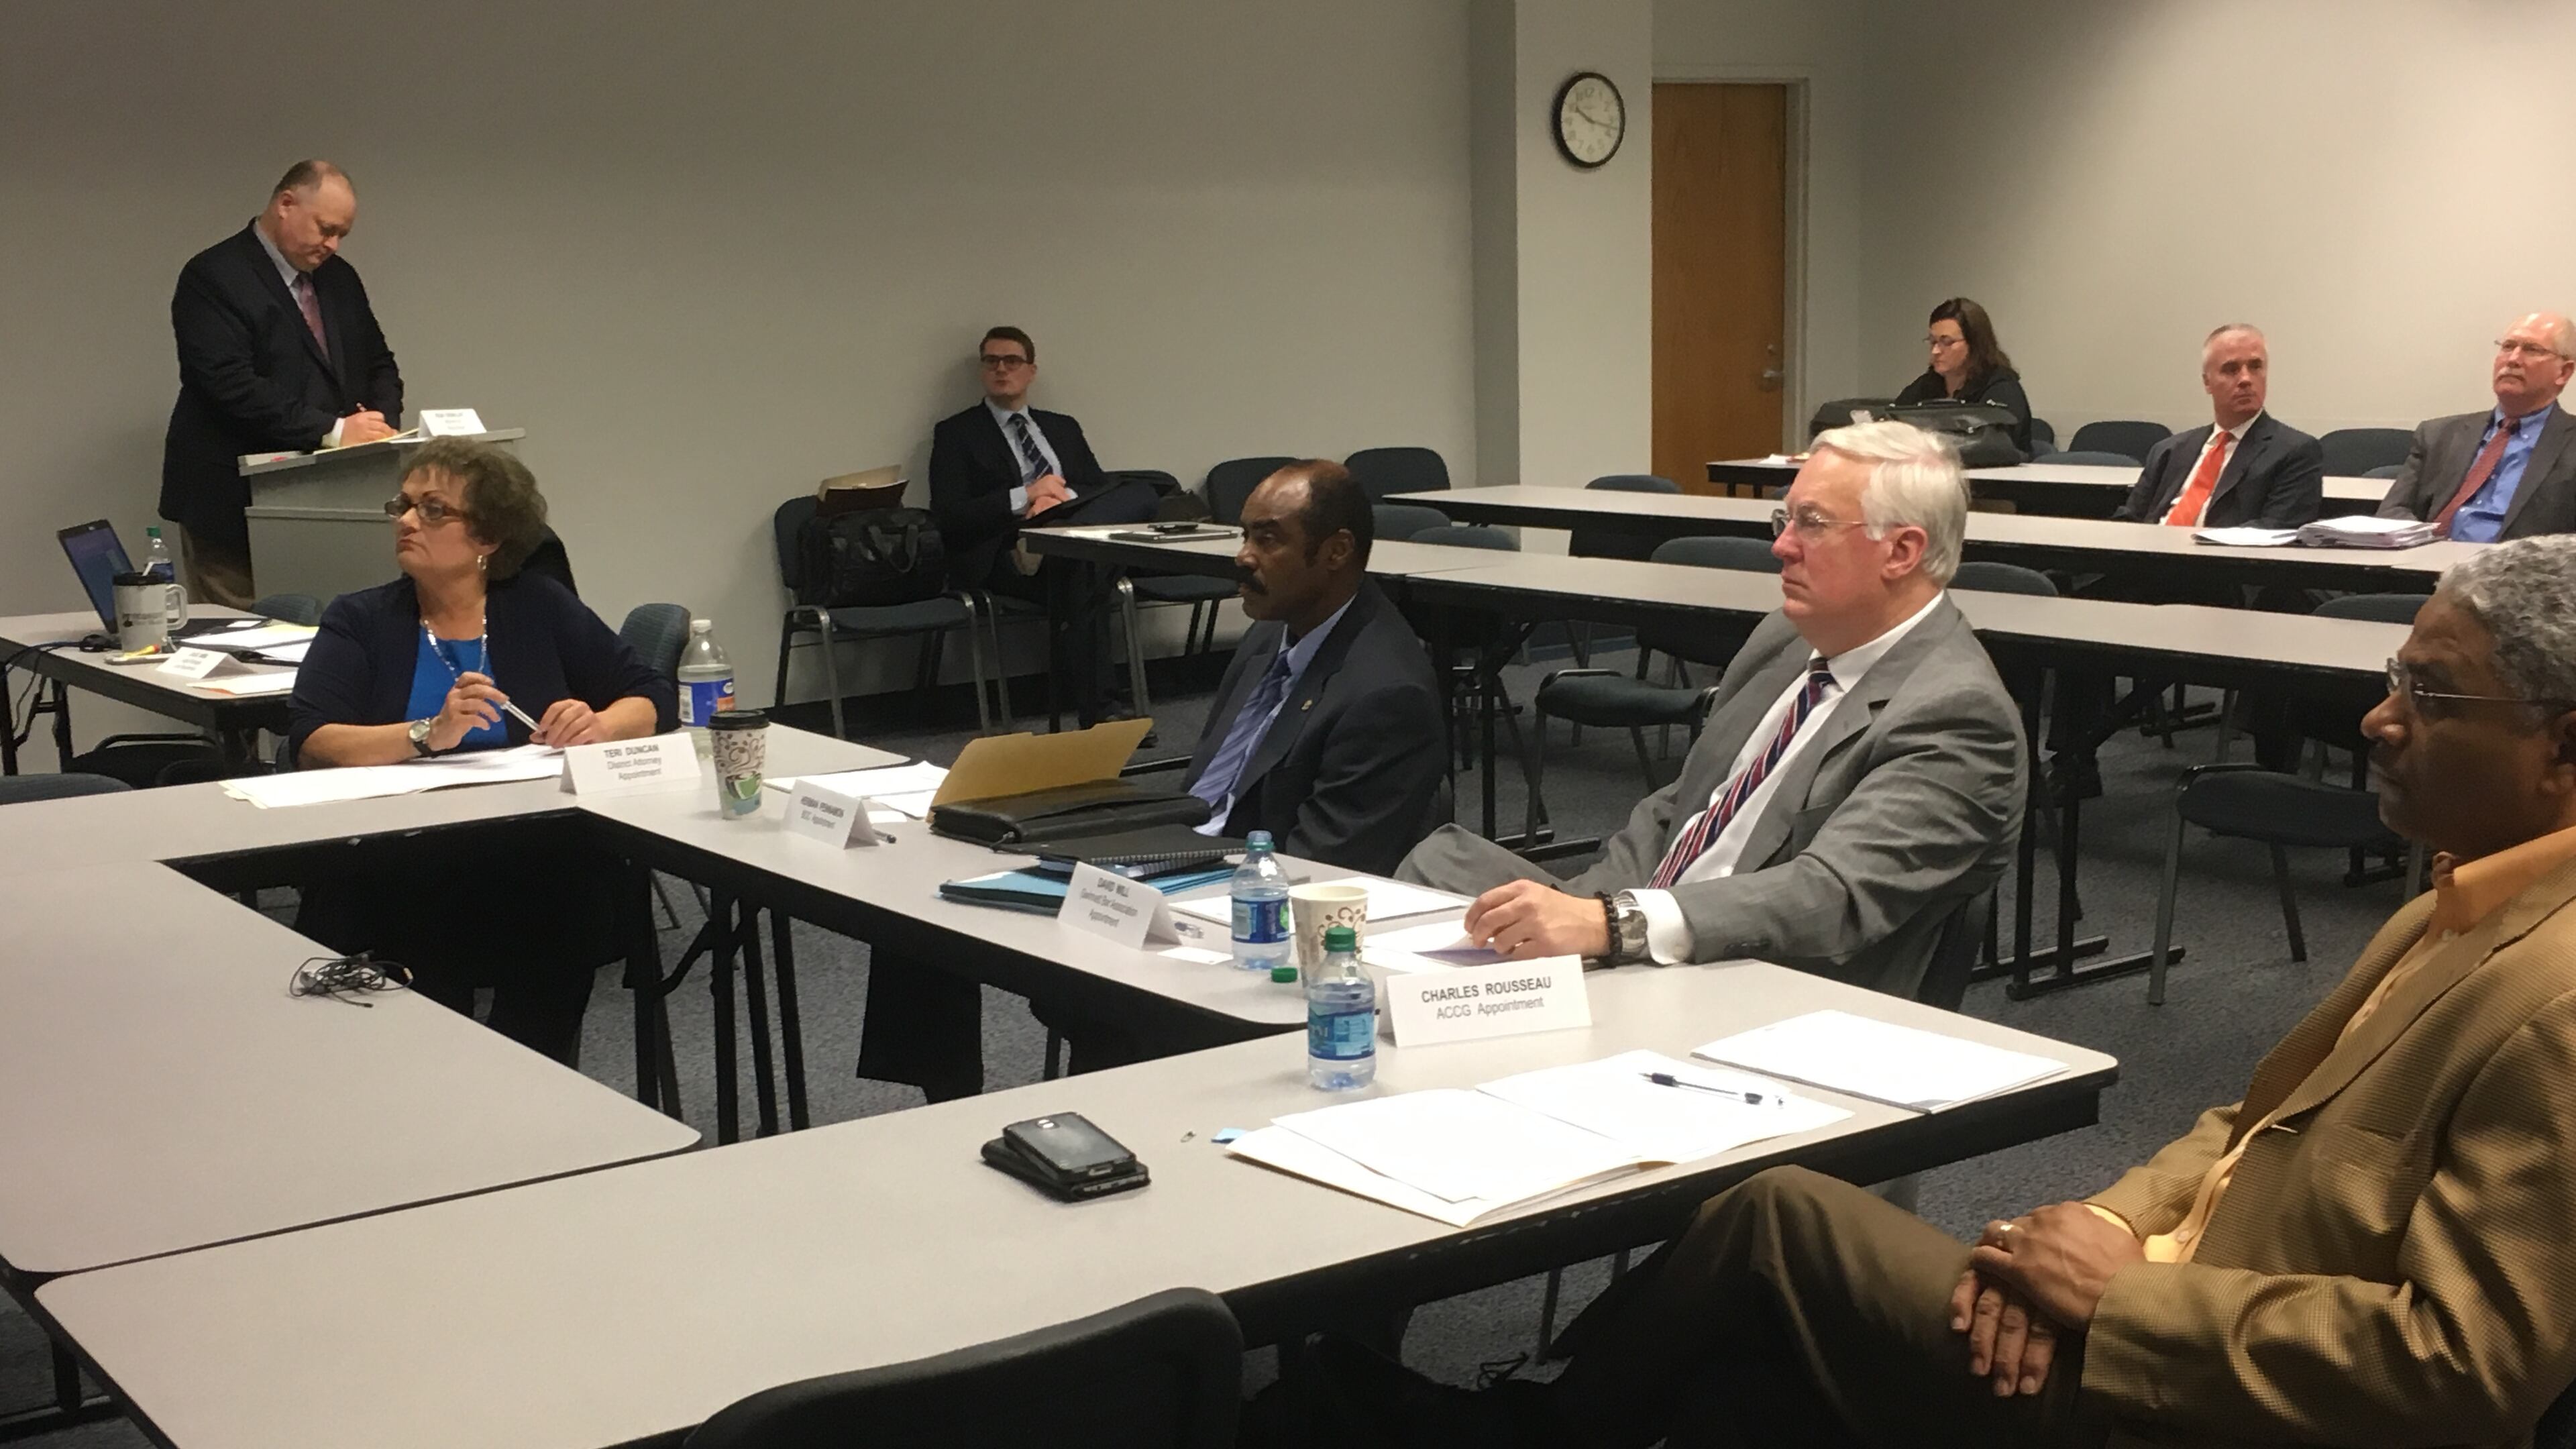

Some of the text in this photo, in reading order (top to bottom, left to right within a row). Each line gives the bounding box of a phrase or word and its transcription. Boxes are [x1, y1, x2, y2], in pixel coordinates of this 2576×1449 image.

[604, 744, 659, 758] TERI DUNCAN
[633, 757, 661, 766] Attorney
[1421, 976, 1552, 1004] CHARLES ROUSSEAU
[1436, 996, 1545, 1020] ACCG Appointment
